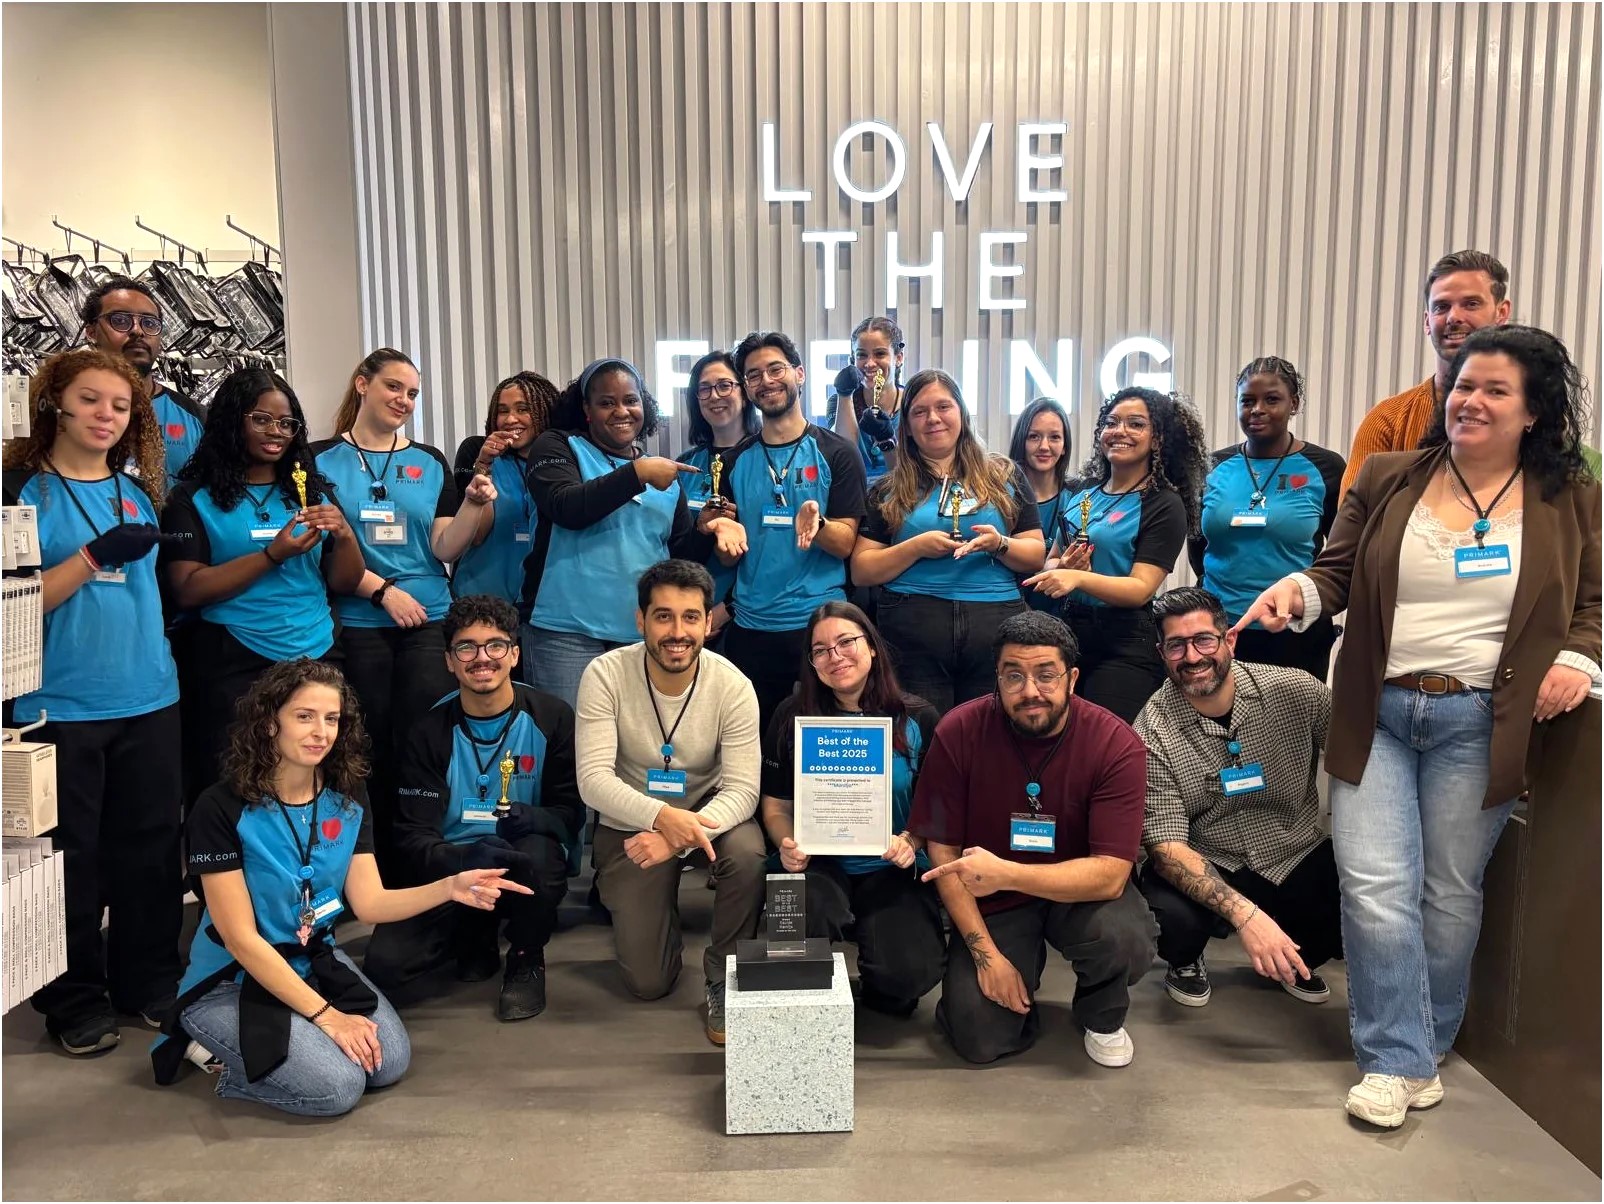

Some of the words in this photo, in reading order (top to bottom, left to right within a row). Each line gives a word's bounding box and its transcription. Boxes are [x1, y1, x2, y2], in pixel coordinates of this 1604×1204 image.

[762, 121, 1068, 203] LOVE
[801, 231, 1028, 310] THE
[655, 337, 1173, 416] FEING
[394, 465, 404, 479] I
[795, 467, 803, 484] I
[1277, 474, 1288, 490] I
[817, 736, 839, 745] Best
[840, 736, 850, 745] of
[853, 737, 869, 746] the
[818, 749, 840, 758] Best
[842, 749, 868, 758] 2025
[1228, 770, 1256, 778] PRIMARK
[311, 895, 331, 906] MARK
[775, 894, 798, 902] BEST
[775, 905, 798, 913] BEST
